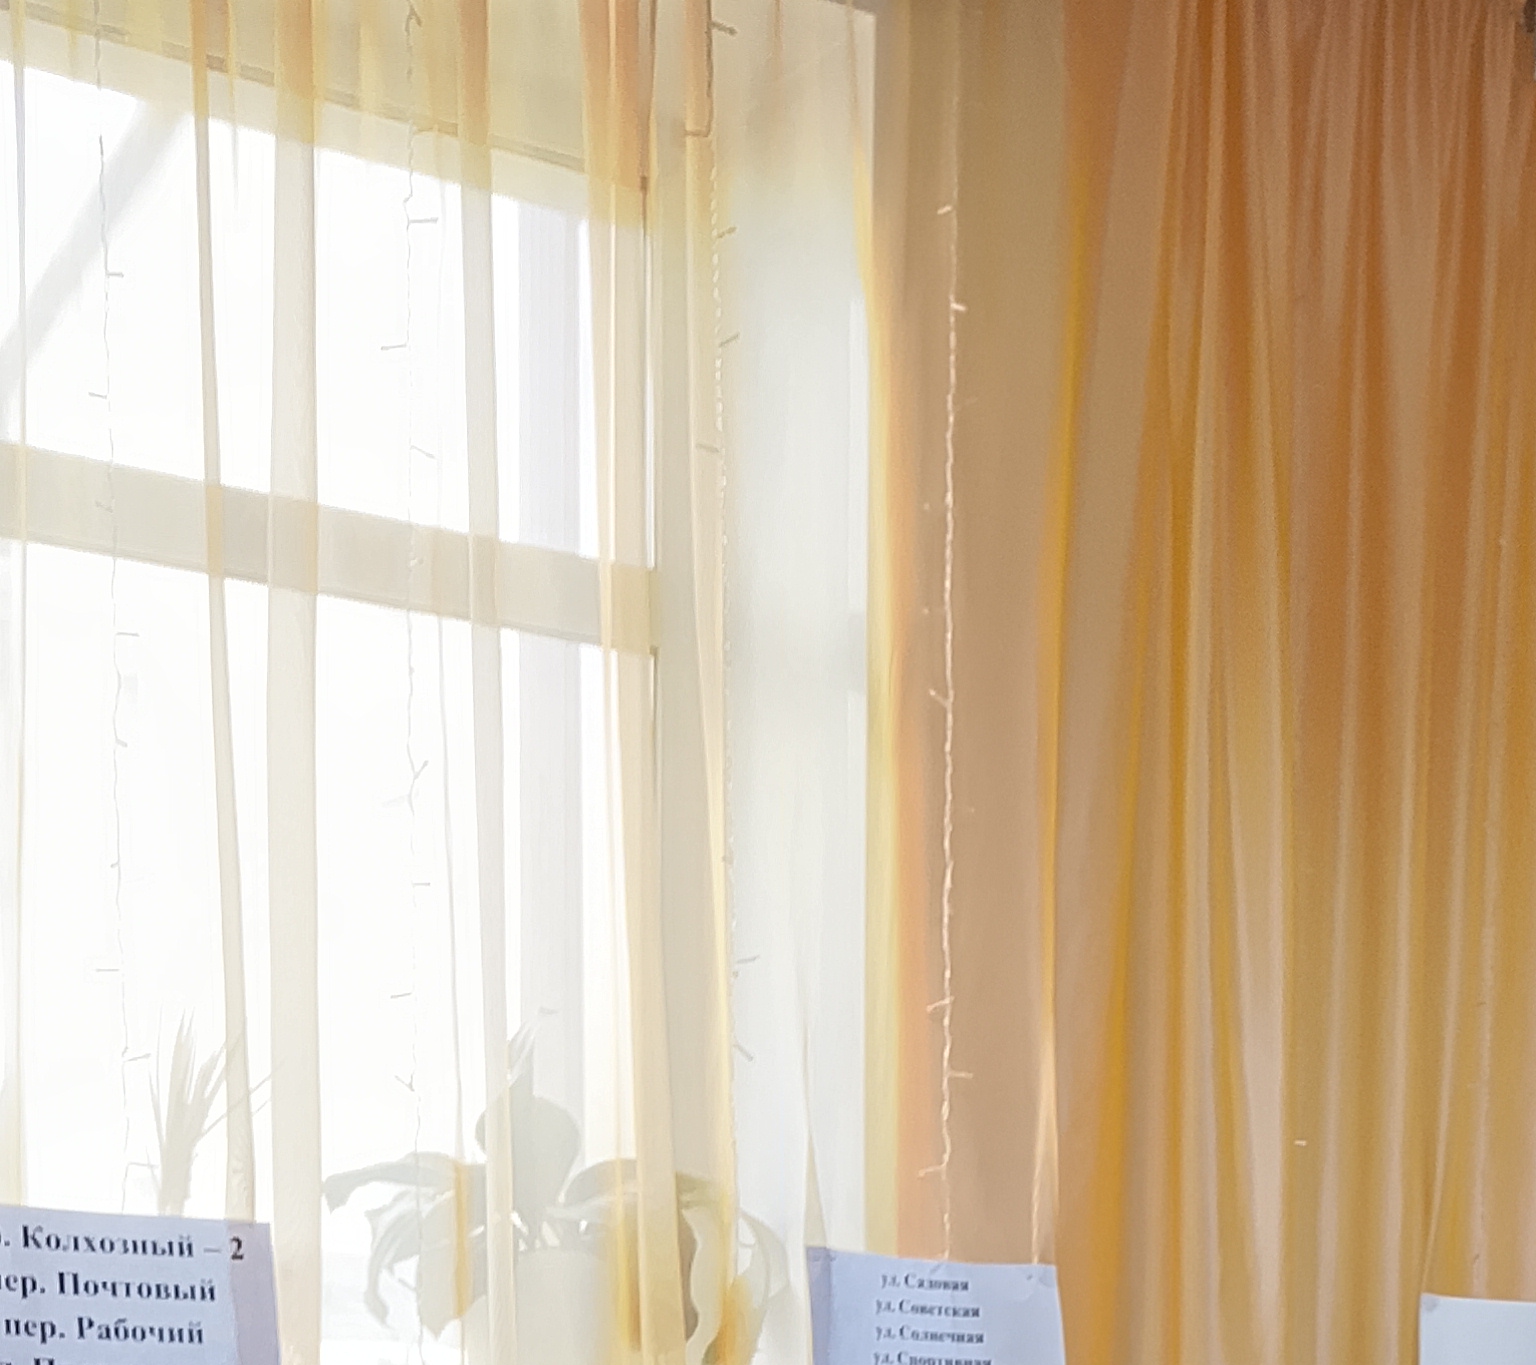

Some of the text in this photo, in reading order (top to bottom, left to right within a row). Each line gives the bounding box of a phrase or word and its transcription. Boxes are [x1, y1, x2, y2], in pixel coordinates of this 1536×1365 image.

[22, 1224, 194, 1258] Колхозный
[229, 1236, 245, 1260] 2
[0, 1271, 216, 1302] ер. Почтовый
[880, 1272, 969, 1292] ул. Садовая
[875, 1298, 980, 1319] ул. Советская
[4, 1316, 203, 1345] пер. Рабочий
[875, 1324, 984, 1345] ул. Солнечная
